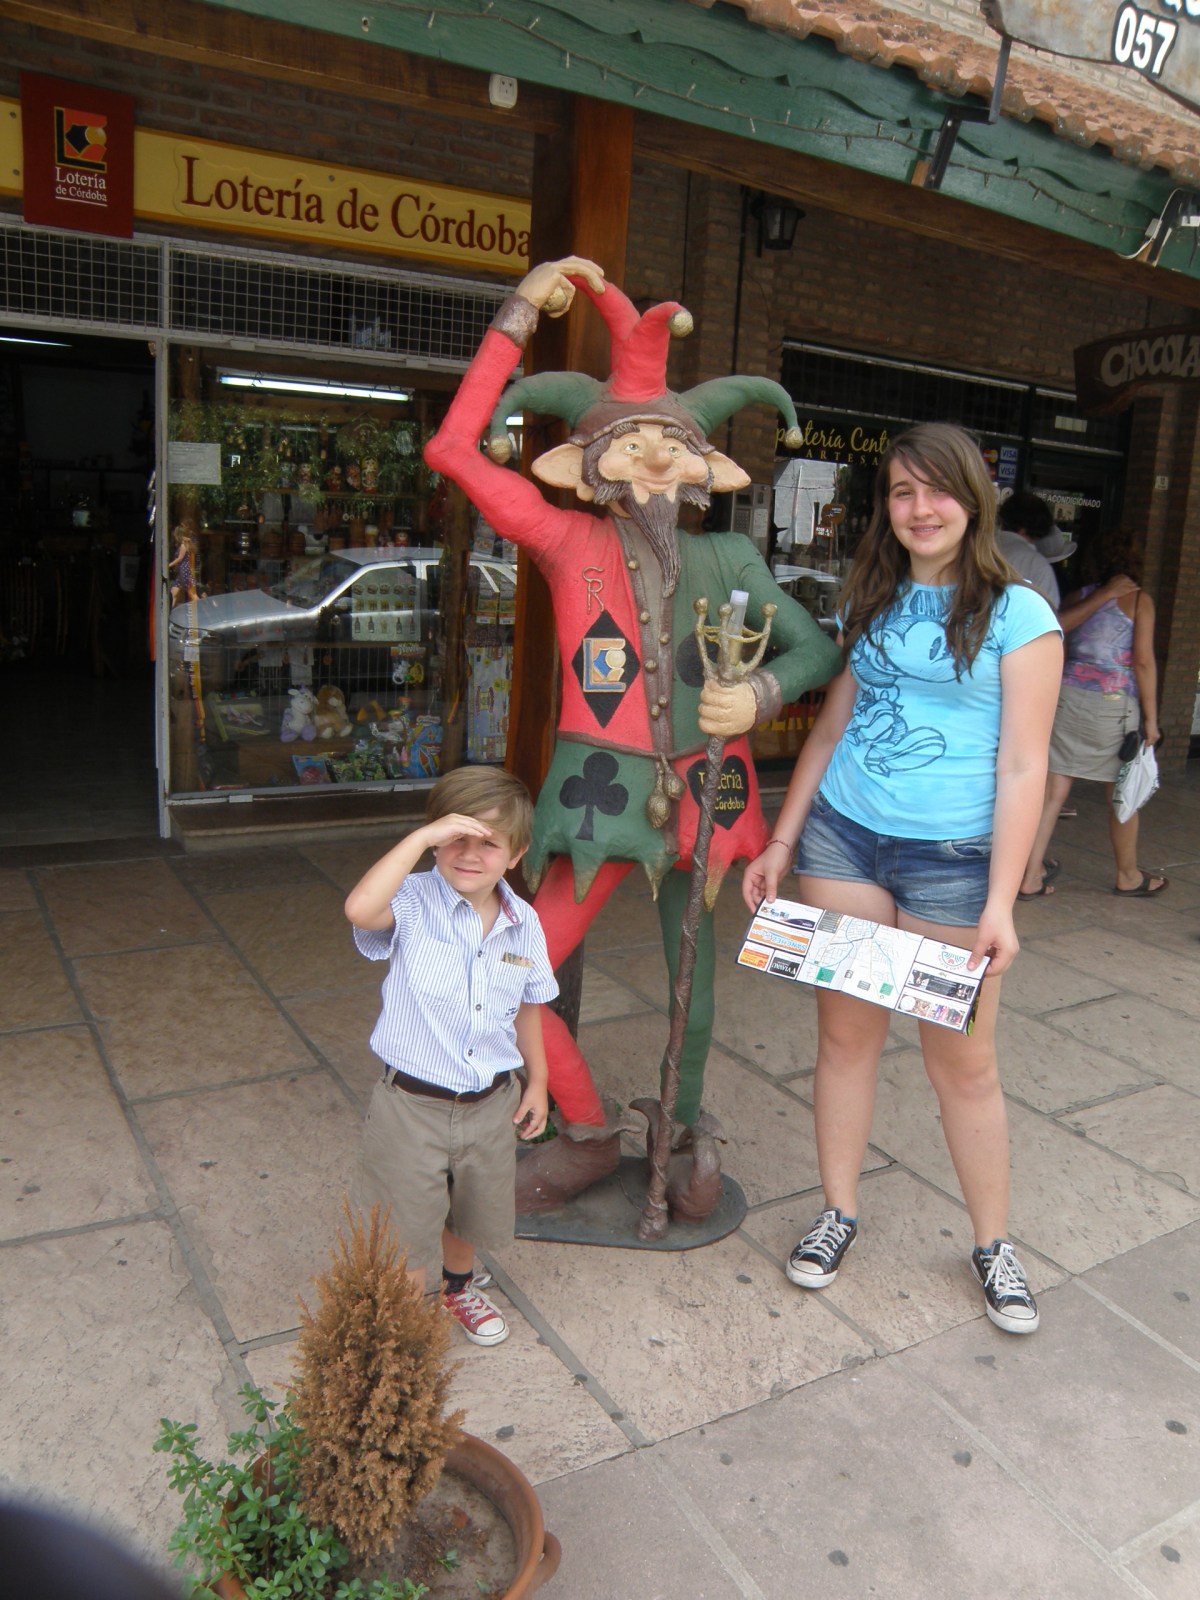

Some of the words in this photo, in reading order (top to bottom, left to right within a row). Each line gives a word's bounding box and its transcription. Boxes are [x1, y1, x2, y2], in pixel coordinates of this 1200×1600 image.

[1114, 6, 1177, 75] 057
[55, 166, 107, 190] Lotería
[55, 184, 67, 195] de
[69, 186, 108, 202] Córdoba
[181, 155, 325, 224] Lotería
[337, 187, 379, 232] de
[390, 193, 531, 258] Córdoba
[1001, 448, 1017, 459] VISA
[1000, 466, 1015, 477] VISA
[1047, 495, 1101, 508] ACONDICIONADO
